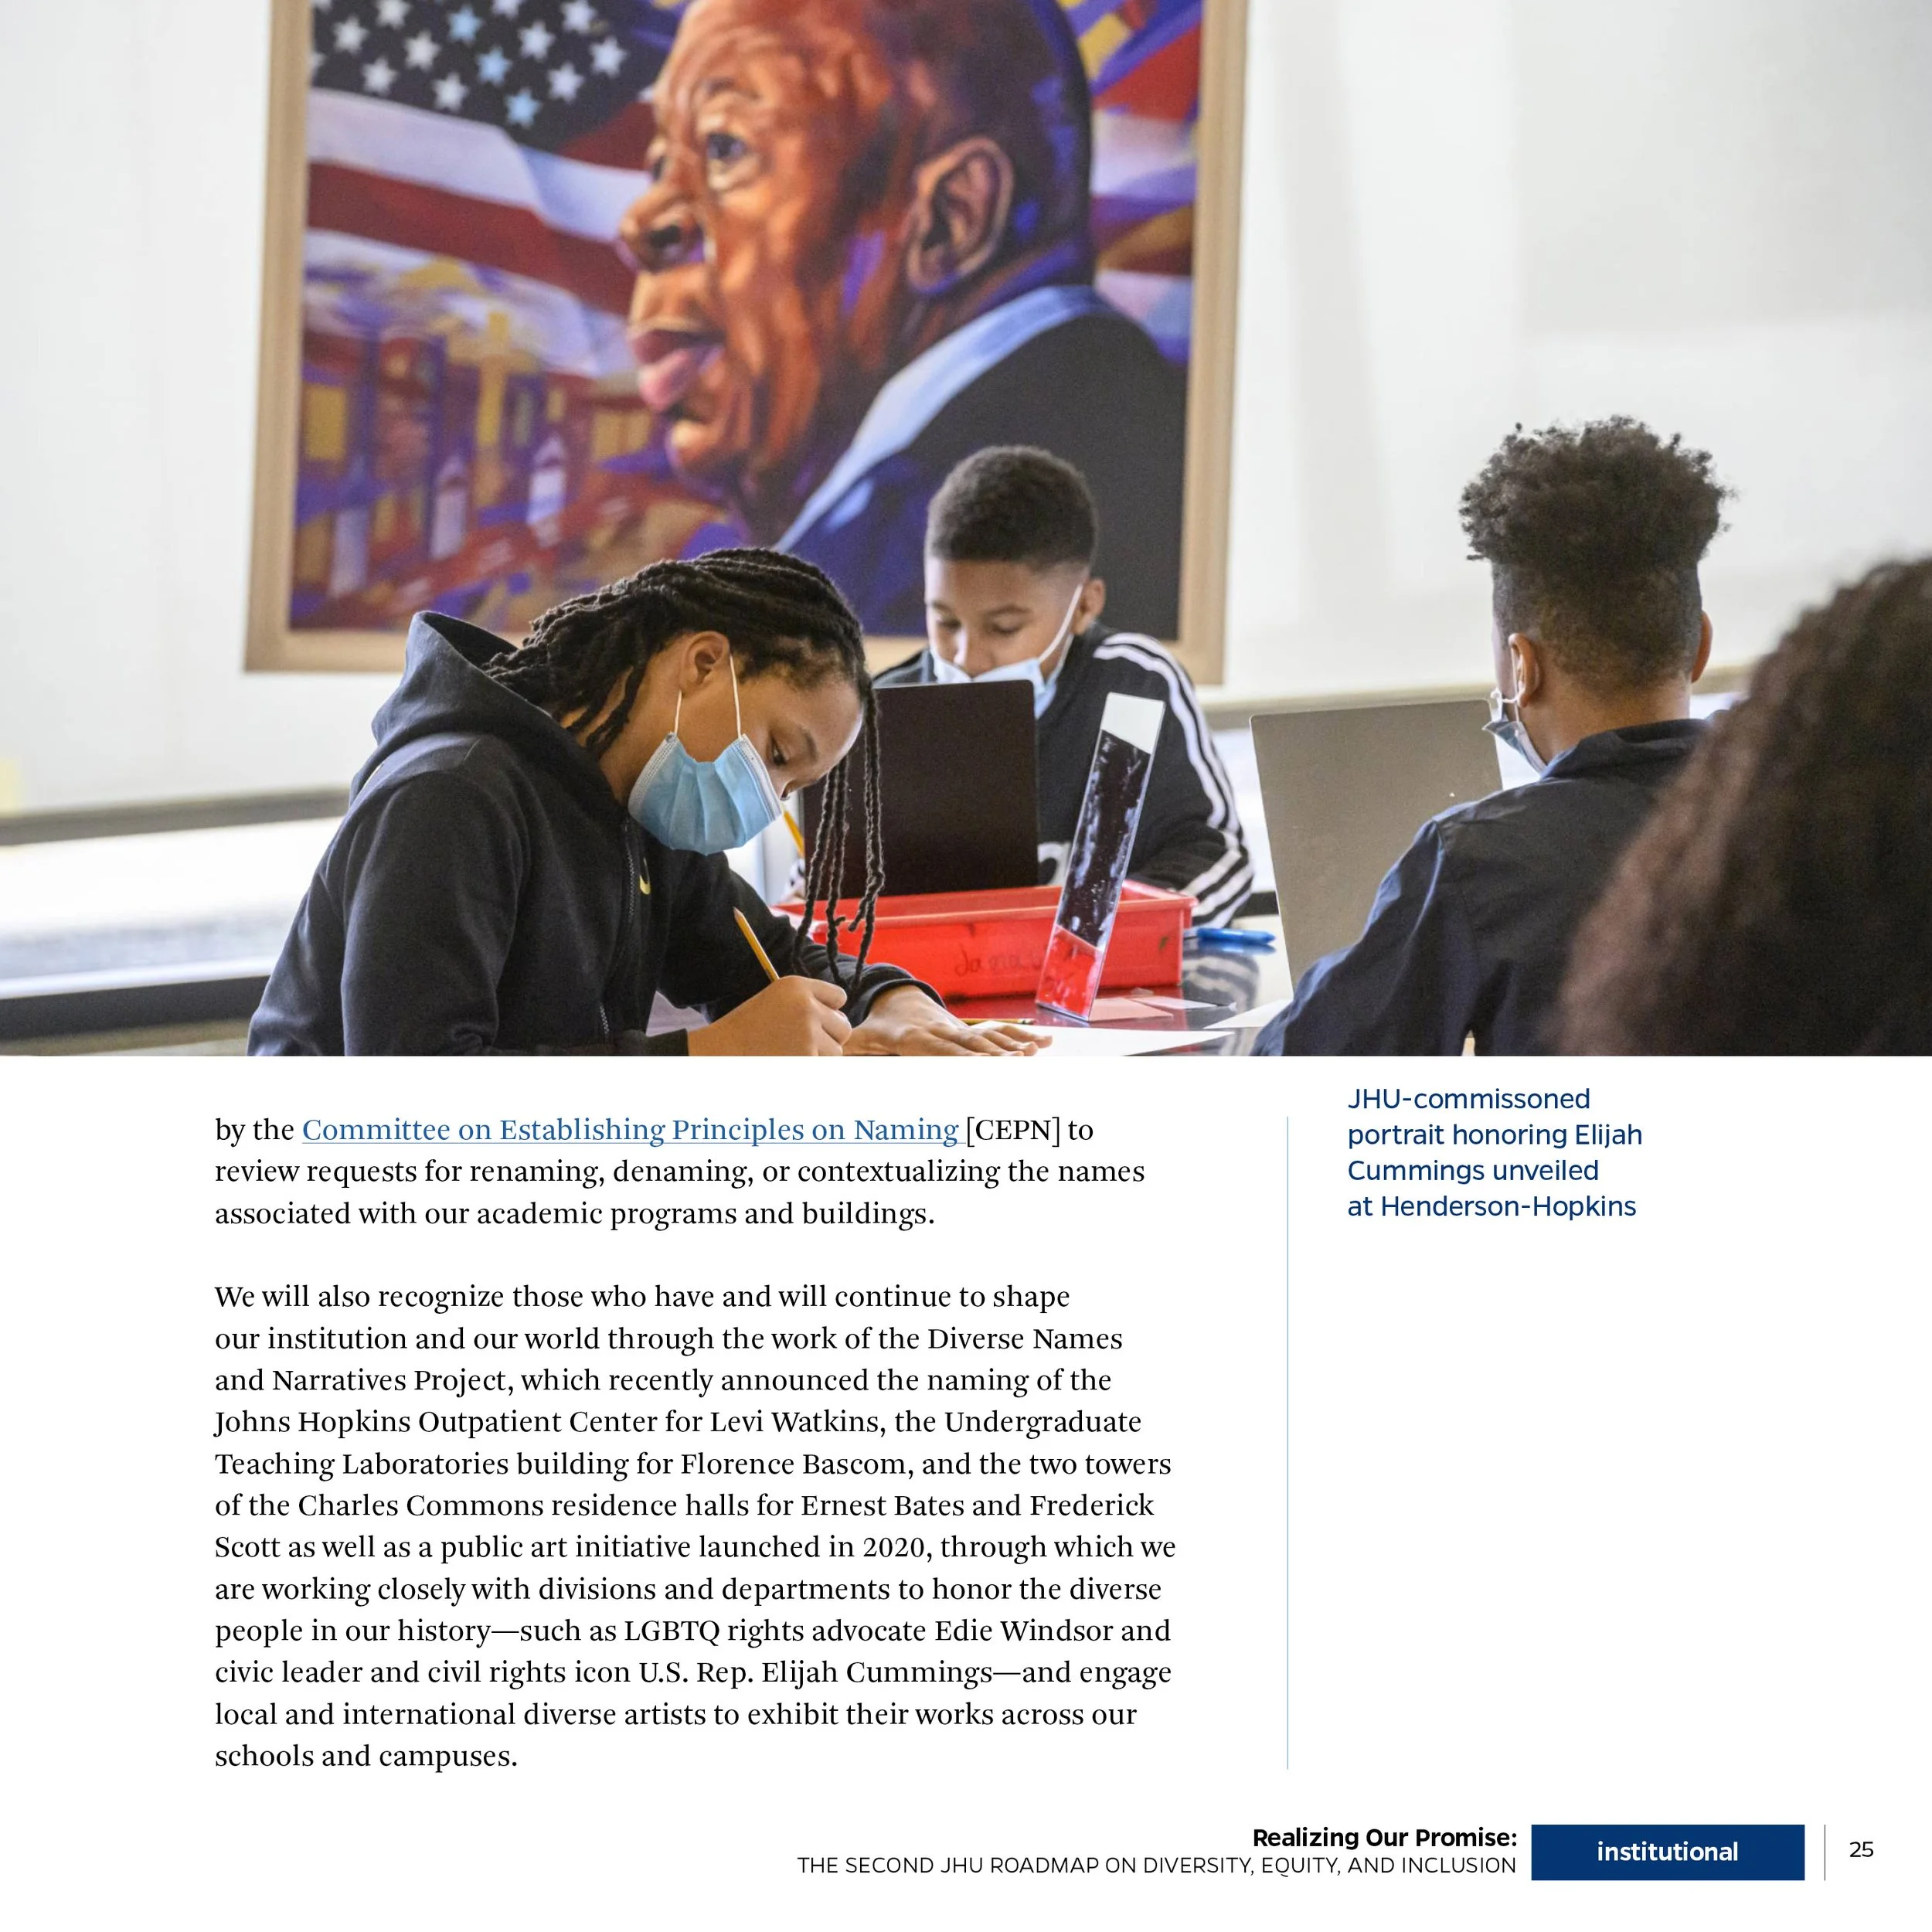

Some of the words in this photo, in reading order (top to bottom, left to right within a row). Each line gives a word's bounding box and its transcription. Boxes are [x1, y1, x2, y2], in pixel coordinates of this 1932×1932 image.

[1347, 1087, 1590, 1110] JHU-commissoned
[215, 1117, 247, 1148] by
[253, 1117, 294, 1141] the
[302, 1117, 451, 1141] Committee
[458, 1124, 491, 1141] on
[500, 1117, 666, 1148] Establishing
[672, 1117, 804, 1147] Principles
[811, 1124, 844, 1141] on
[854, 1117, 960, 1148] Naming
[967, 1116, 1060, 1148] [CEPN]
[1067, 1120, 1094, 1141] to
[1349, 1124, 1445, 1150] portrait
[1453, 1124, 1567, 1149] honoring
[1576, 1123, 1642, 1149] Elijah
[215, 1158, 301, 1182] review
[307, 1162, 417, 1189] requests
[424, 1158, 463, 1182] for
[470, 1158, 604, 1189] renaming,
[613, 1158, 753, 1189] denaming,
[763, 1165, 791, 1182] or
[798, 1158, 1002, 1189] contextualizing
[1007, 1158, 1049, 1182] the
[1058, 1165, 1145, 1182] names
[1348, 1159, 1485, 1185] Cummings
[1493, 1159, 1599, 1181] unveiled
[215, 1200, 352, 1225] associated
[358, 1200, 417, 1225] with
[425, 1208, 470, 1225] our
[477, 1200, 603, 1225] academic
[610, 1208, 737, 1232] programs
[745, 1201, 794, 1225] and
[801, 1200, 934, 1232] buildings.
[1348, 1196, 1373, 1216] at
[1382, 1195, 1637, 1221] Henderson-Hopkins
[215, 1368, 265, 1391] and
[272, 1367, 406, 1391] Narratives
[413, 1367, 514, 1398] Project,
[520, 1367, 601, 1391] which
[608, 1368, 714, 1398] recently
[721, 1368, 869, 1391] announced
[876, 1368, 919, 1391] the
[927, 1367, 1030, 1398] naming
[1036, 1367, 1065, 1391] of
[1070, 1368, 1111, 1391] the
[213, 1409, 291, 1438] Johns
[298, 1408, 411, 1439] Hopkins
[418, 1409, 563, 1439] Outpatient
[570, 1411, 658, 1433] Center
[665, 1409, 703, 1433] for
[710, 1409, 764, 1433] Levi
[770, 1408, 886, 1438] Watkins,
[894, 1409, 936, 1433] the
[944, 1409, 1141, 1440] Undergraduate
[214, 1451, 335, 1482] Teaching
[342, 1451, 509, 1475] Laboratories
[516, 1451, 630, 1482] building
[636, 1451, 674, 1475] for
[681, 1451, 794, 1475] Florence
[802, 1454, 913, 1480] Bascom,
[922, 1451, 971, 1475] and
[978, 1451, 1021, 1475] the
[1029, 1454, 1077, 1475] two
[1084, 1454, 1172, 1475] towers
[215, 1492, 243, 1516] of
[248, 1493, 290, 1516] the
[298, 1493, 399, 1516] Charles
[406, 1495, 544, 1516] Commons
[551, 1492, 677, 1516] residence
[685, 1493, 750, 1516] halls
[757, 1492, 794, 1516] for
[801, 1495, 887, 1516] Ernest
[893, 1495, 964, 1516] Bates
[972, 1493, 1022, 1516] and
[1029, 1492, 1155, 1516] Frederick
[215, 1536, 281, 1558] Scott
[288, 1541, 315, 1558] as
[321, 1534, 376, 1558] well
[383, 1541, 411, 1558] as
[418, 1541, 434, 1558] a
[440, 1534, 523, 1564] public
[531, 1537, 568, 1558] art
[575, 1534, 691, 1558] initiative
[699, 1534, 821, 1558] launched
[828, 1534, 855, 1557] in
[862, 1537, 933, 1563] 2020,
[940, 1534, 1048, 1565] through
[1053, 1534, 1134, 1558] which
[1140, 1541, 1176, 1558] we
[215, 1583, 255, 1600] are
[261, 1576, 372, 1607] working
[378, 1577, 467, 1607] closely
[471, 1577, 531, 1600] with
[539, 1577, 656, 1600] divisions
[665, 1577, 714, 1600] and
[722, 1577, 890, 1607] departments
[898, 1580, 924, 1600] to
[932, 1577, 1012, 1600] honor
[1019, 1577, 1061, 1600] the
[1070, 1577, 1162, 1600] diverse
[215, 1618, 303, 1648] people
[311, 1617, 338, 1641] in
[345, 1624, 391, 1641] our
[397, 1617, 582, 1649] history—such
[590, 1625, 617, 1641] as
[624, 1620, 720, 1647] LGBTQ
[727, 1617, 804, 1649] rights
[812, 1618, 926, 1641] advocate
[934, 1617, 992, 1641] Edie
[999, 1617, 1114, 1641] Windsor
[1121, 1618, 1172, 1641] and
[215, 1659, 274, 1683] civic
[281, 1659, 363, 1683] leader
[370, 1660, 420, 1683] and
[427, 1659, 481, 1683] civil
[489, 1659, 566, 1690] rights
[574, 1659, 631, 1683] icon
[638, 1662, 689, 1683] U.S.
[696, 1662, 753, 1689] Rep.
[761, 1659, 838, 1690] Elijah
[846, 1659, 1072, 1690] Cummings—and
[1080, 1666, 1172, 1690] engage
[215, 1702, 277, 1726] local
[285, 1702, 335, 1726] and
[342, 1702, 516, 1726] international
[524, 1702, 616, 1726] diverse
[624, 1702, 706, 1726] artists
[713, 1705, 740, 1726] to
[747, 1702, 839, 1726] exhibit
[845, 1702, 910, 1726] their
[914, 1701, 994, 1726] works
[1002, 1709, 1084, 1726] across
[1092, 1709, 1138, 1726] our
[215, 1743, 315, 1767] schools
[321, 1743, 372, 1767] and
[379, 1750, 517, 1774] campuses.
[1253, 1826, 1359, 1851] Realizing
[1366, 1828, 1409, 1847] Our
[1416, 1826, 1517, 1847] Promise:
[1597, 1840, 1738, 1862] institutional
[1849, 1841, 1874, 1858] 25
[797, 1857, 838, 1873] THE
[845, 1857, 934, 1873] SECOND
[940, 1857, 983, 1873] JHU
[991, 1857, 1099, 1873] ROADMAP
[1105, 1857, 1136, 1873] ON
[1144, 1857, 1254, 1876] DIVERSITY,
[1262, 1857, 1341, 1878] EQUITY,
[1347, 1857, 1395, 1873] AND
[1403, 1856, 1515, 1873] INCLUSION
